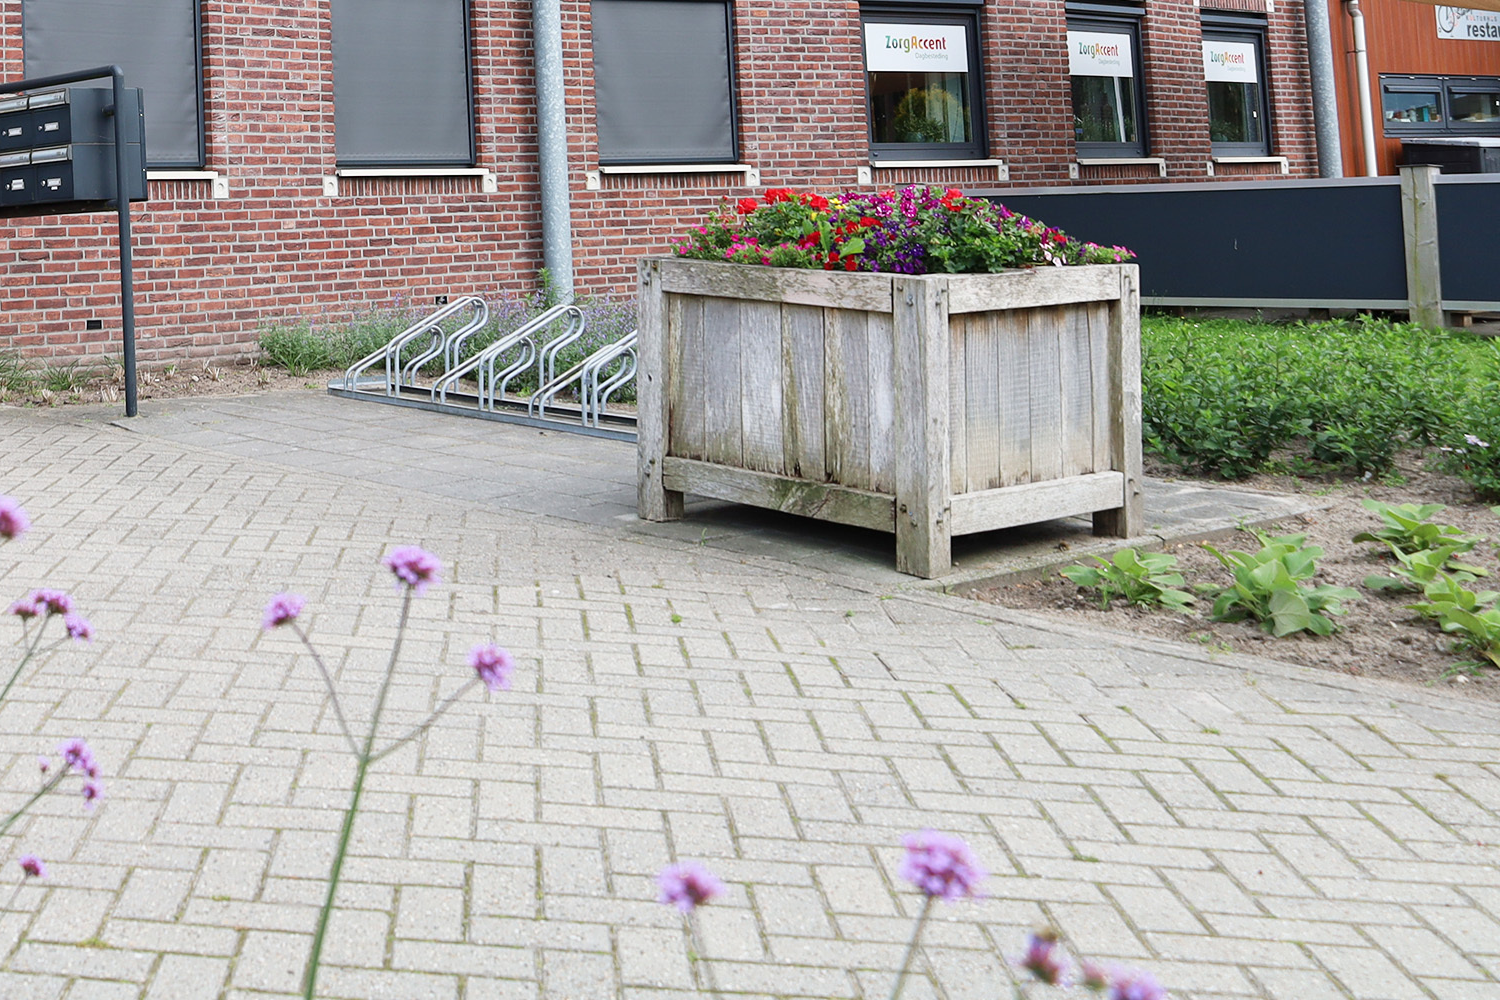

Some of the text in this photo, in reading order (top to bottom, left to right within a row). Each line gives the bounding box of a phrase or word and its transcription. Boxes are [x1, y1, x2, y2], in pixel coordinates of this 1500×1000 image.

[885, 35, 947, 53] ZorgAccent
[1078, 42, 1119, 59] ZorgAccent
[1210, 51, 1245, 66] ZorgAccent
